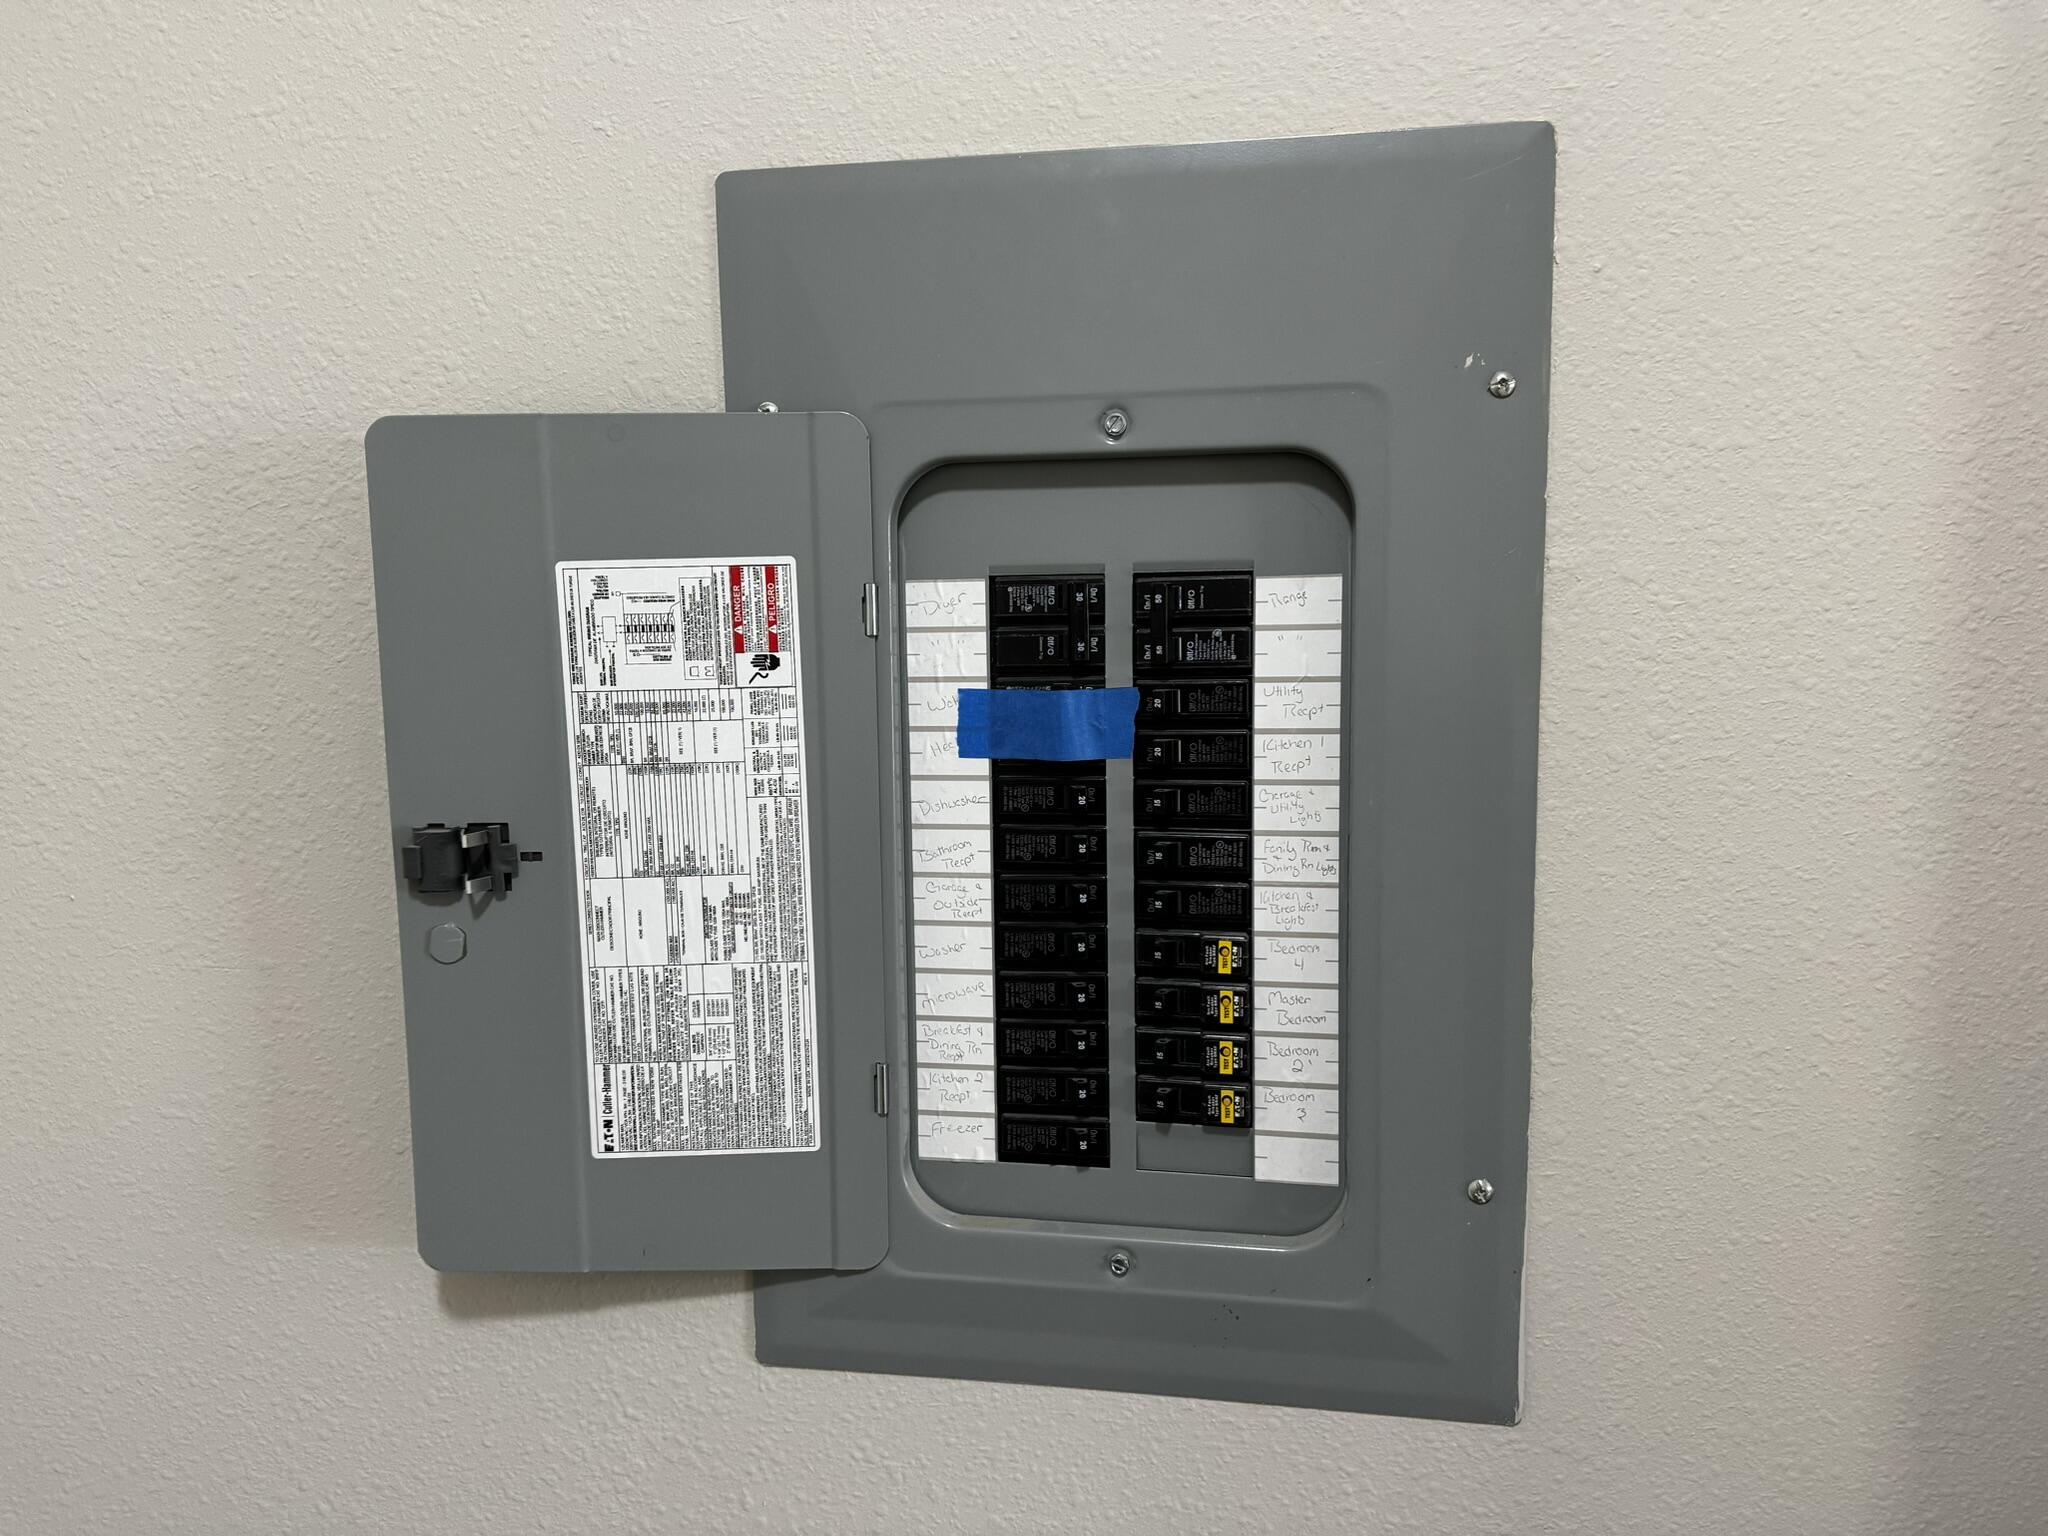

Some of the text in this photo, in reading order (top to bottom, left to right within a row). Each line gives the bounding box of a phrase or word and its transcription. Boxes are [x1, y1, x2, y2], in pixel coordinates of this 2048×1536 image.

[767, 583, 776, 621] PELIGRO
[1076, 592, 1083, 602] 30
[1155, 594, 1162, 604] 50
[1269, 591, 1308, 608] Range
[733, 585, 742, 622] DANGER
[922, 593, 967, 616] Dryer
[1077, 642, 1084, 652] 30
[1156, 645, 1163, 655] 50
[1263, 687, 1303, 704] Utility
[1154, 698, 1161, 709] 20
[1263, 737, 1313, 752] Kitchen
[1154, 748, 1162, 757] 20
[919, 795, 987, 816] Dishwasher
[1078, 796, 1086, 805] 20
[1154, 799, 1161, 807] 15
[1271, 801, 1305, 814] Utility
[919, 839, 972, 863] Bathroom
[1078, 844, 1086, 853] 20
[1155, 852, 1163, 861] 15
[1080, 894, 1087, 904] 20
[1155, 900, 1163, 909] 15
[919, 942, 966, 958] Washer
[1078, 943, 1085, 953] 20
[1267, 938, 1321, 955] Bedroom
[1155, 951, 1162, 959] 15
[1294, 958, 1304, 971] 4
[1078, 993, 1086, 1003] 20
[1268, 992, 1311, 1005] Master
[1155, 1001, 1162, 1010] 15
[1276, 1009, 1327, 1026] Bedroom
[1078, 1041, 1086, 1050] 20
[1267, 1041, 1319, 1057] Bedroom
[1156, 1051, 1164, 1060] 15
[929, 1072, 984, 1085] Kitchen 2
[601, 1064, 612, 1114] Cutler-Hammer
[1079, 1089, 1087, 1099] 20
[1264, 1088, 1315, 1102] Bedroom
[1157, 1101, 1164, 1109] 15
[931, 1122, 983, 1136] Freezer
[603, 1119, 614, 1152] EATON
[1079, 1141, 1087, 1150] 20
